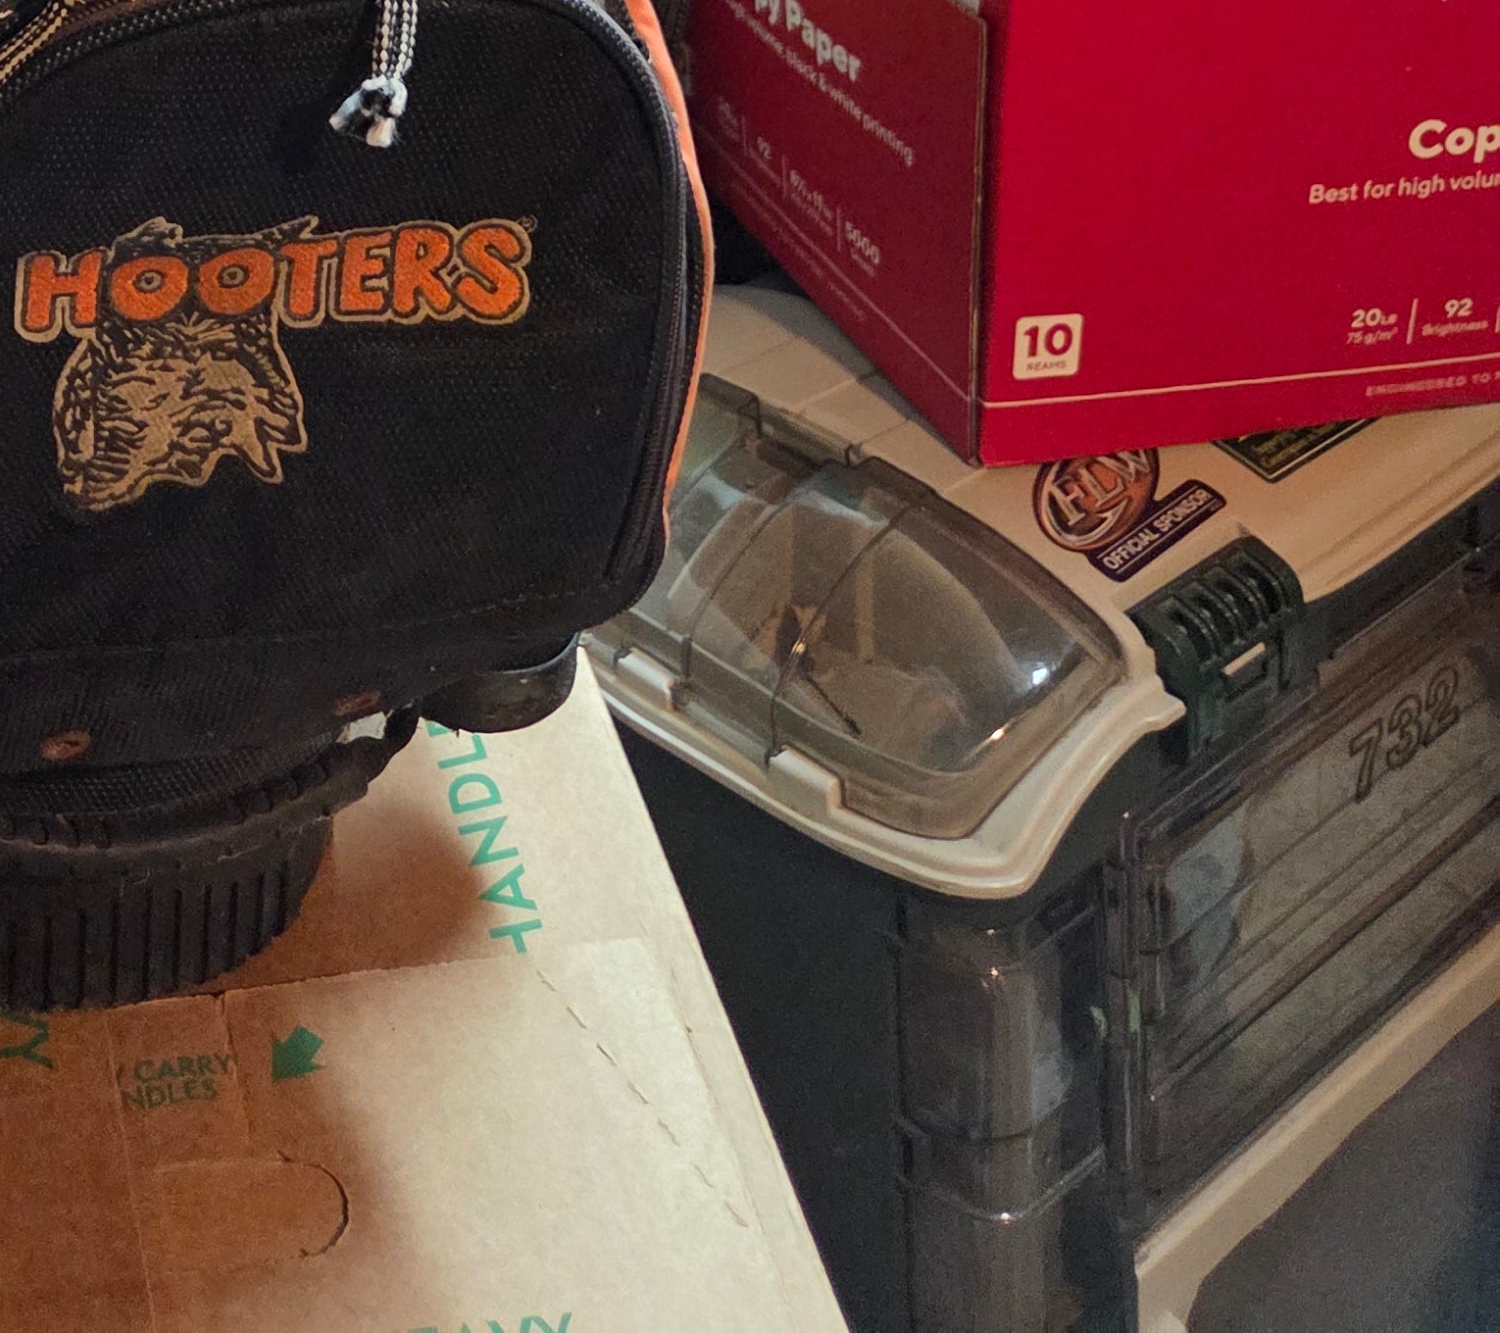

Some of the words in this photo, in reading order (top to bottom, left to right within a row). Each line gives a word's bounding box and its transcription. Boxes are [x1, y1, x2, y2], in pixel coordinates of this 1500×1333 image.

[1309, 184, 1359, 205] Best
[1363, 180, 1396, 201] for
[1398, 174, 1446, 200] high
[15, 221, 530, 342] HOOTERS
[1444, 297, 1474, 318] 92
[1024, 323, 1073, 358] 10
[1049, 447, 1154, 527] FLW
[1102, 528, 1159, 571] OFFICIAL
[1152, 487, 1214, 534] SPONSOR
[1348, 665, 1461, 804] 732
[133, 1052, 237, 1084] CARRY
